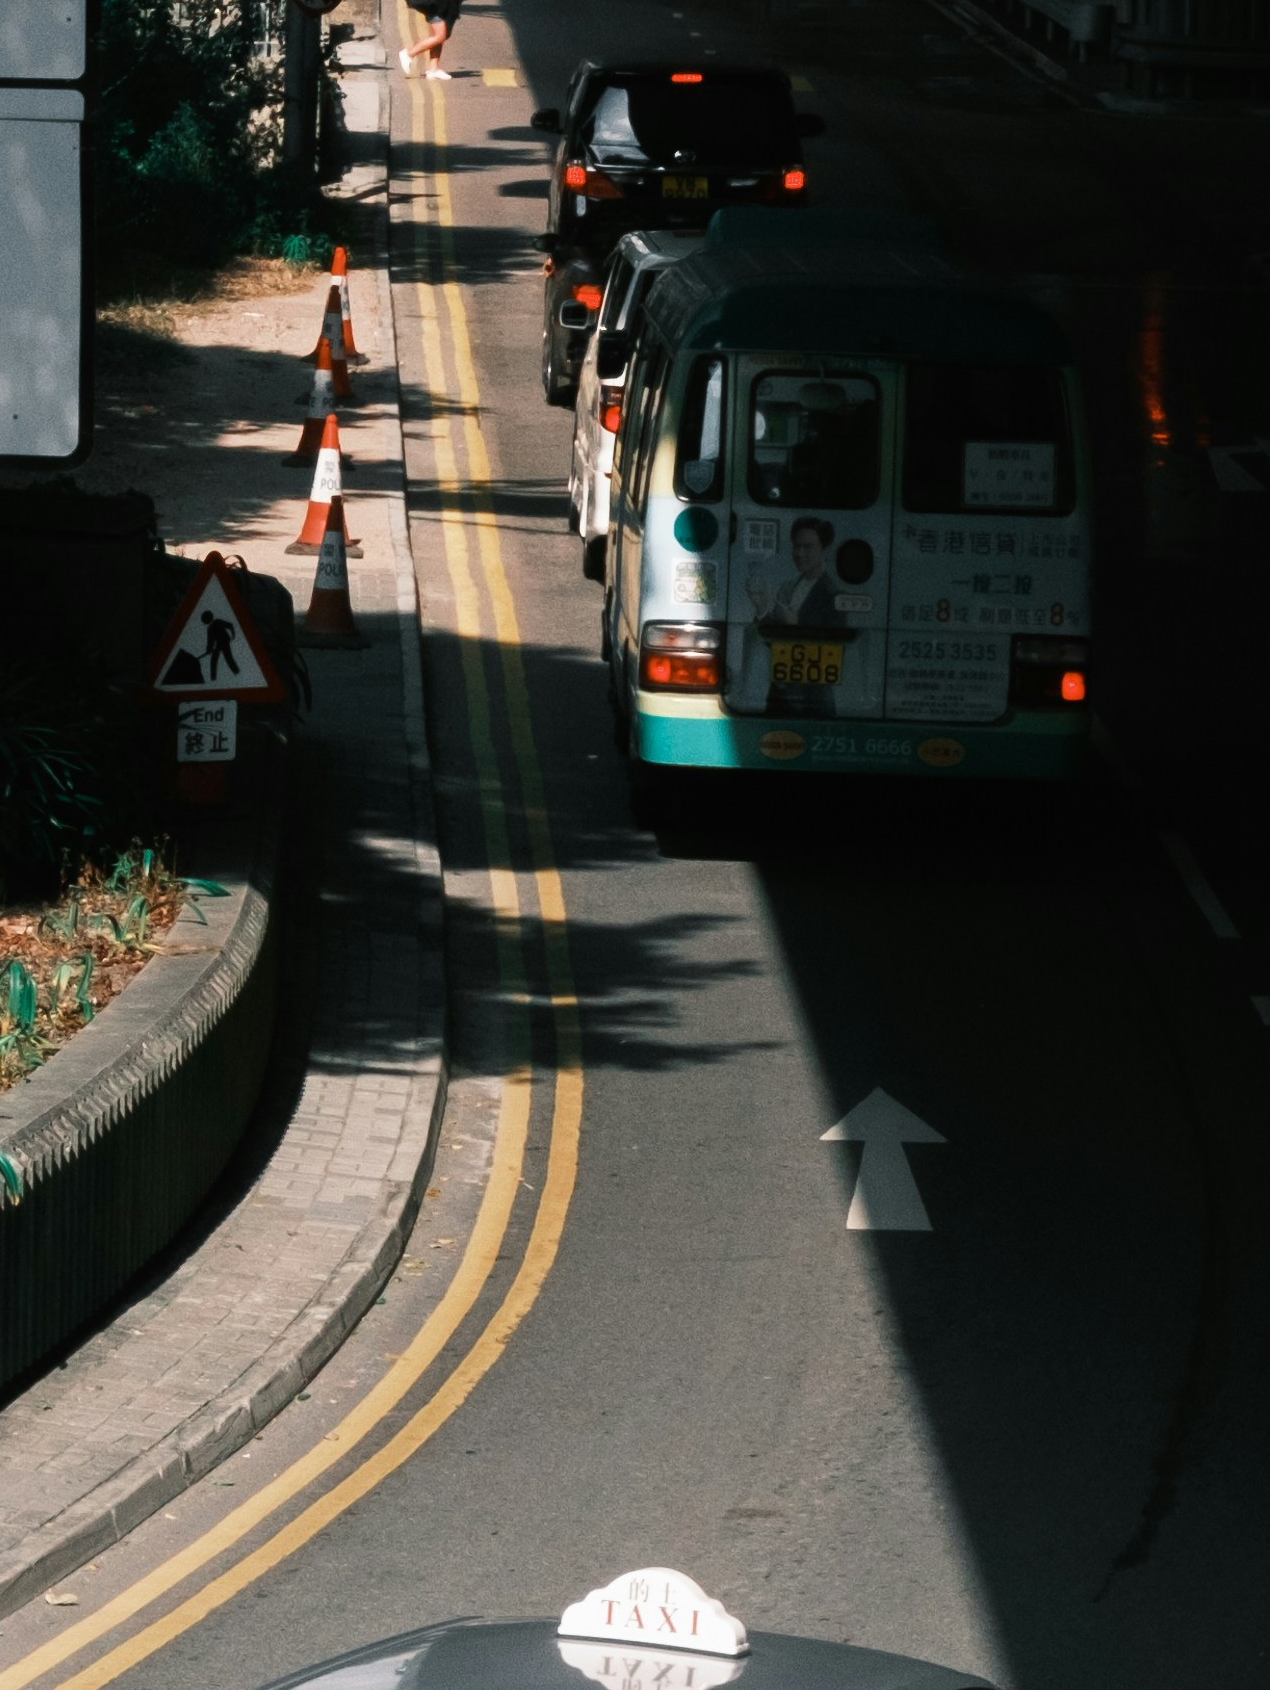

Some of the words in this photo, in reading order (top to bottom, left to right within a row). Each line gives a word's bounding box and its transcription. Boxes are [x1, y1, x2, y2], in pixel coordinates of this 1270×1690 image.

[791, 644, 822, 663] GJ
[773, 662, 838, 683] 6608
[194, 707, 224, 723] End
[185, 732, 228, 754] 終止
[811, 736, 858, 754] 2751
[865, 738, 912, 756] 6666
[602, 1599, 700, 1635] TAXI
